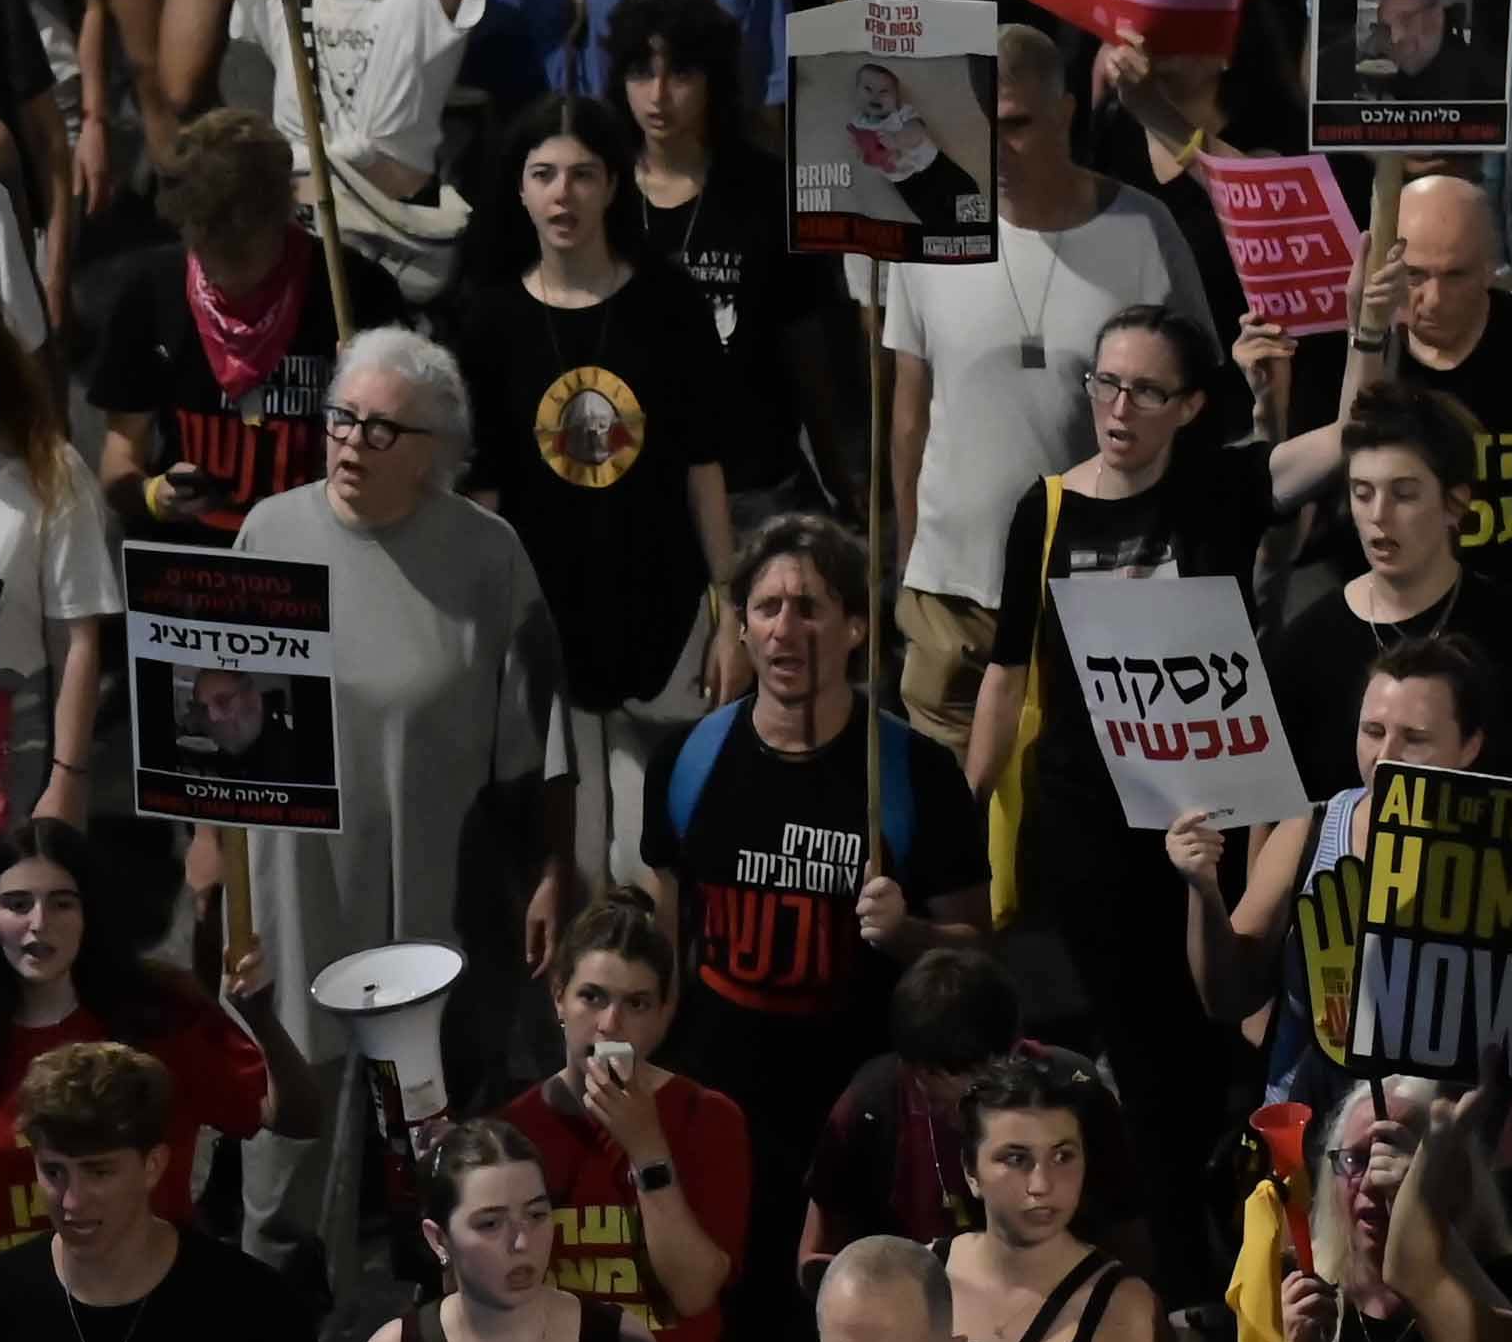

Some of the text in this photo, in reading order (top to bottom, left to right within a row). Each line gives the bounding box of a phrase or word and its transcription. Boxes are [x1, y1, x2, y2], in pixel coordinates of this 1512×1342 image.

[1360, 108, 1462, 125] סליחה אלכס
[795, 162, 852, 189] BRING
[795, 187, 832, 213] HIM
[1265, 179, 1307, 209] רק
[1285, 231, 1332, 264] רק
[148, 621, 310, 660] אלכס דנציג
[1085, 651, 1249, 720] עסקה
[1105, 715, 1269, 762] עכשיו
[184, 781, 289, 805] סליחה אלכס
[1378, 772, 1455, 833] ALL
[781, 822, 861, 864] מחזירים
[735, 847, 858, 895] אותם הביתה
